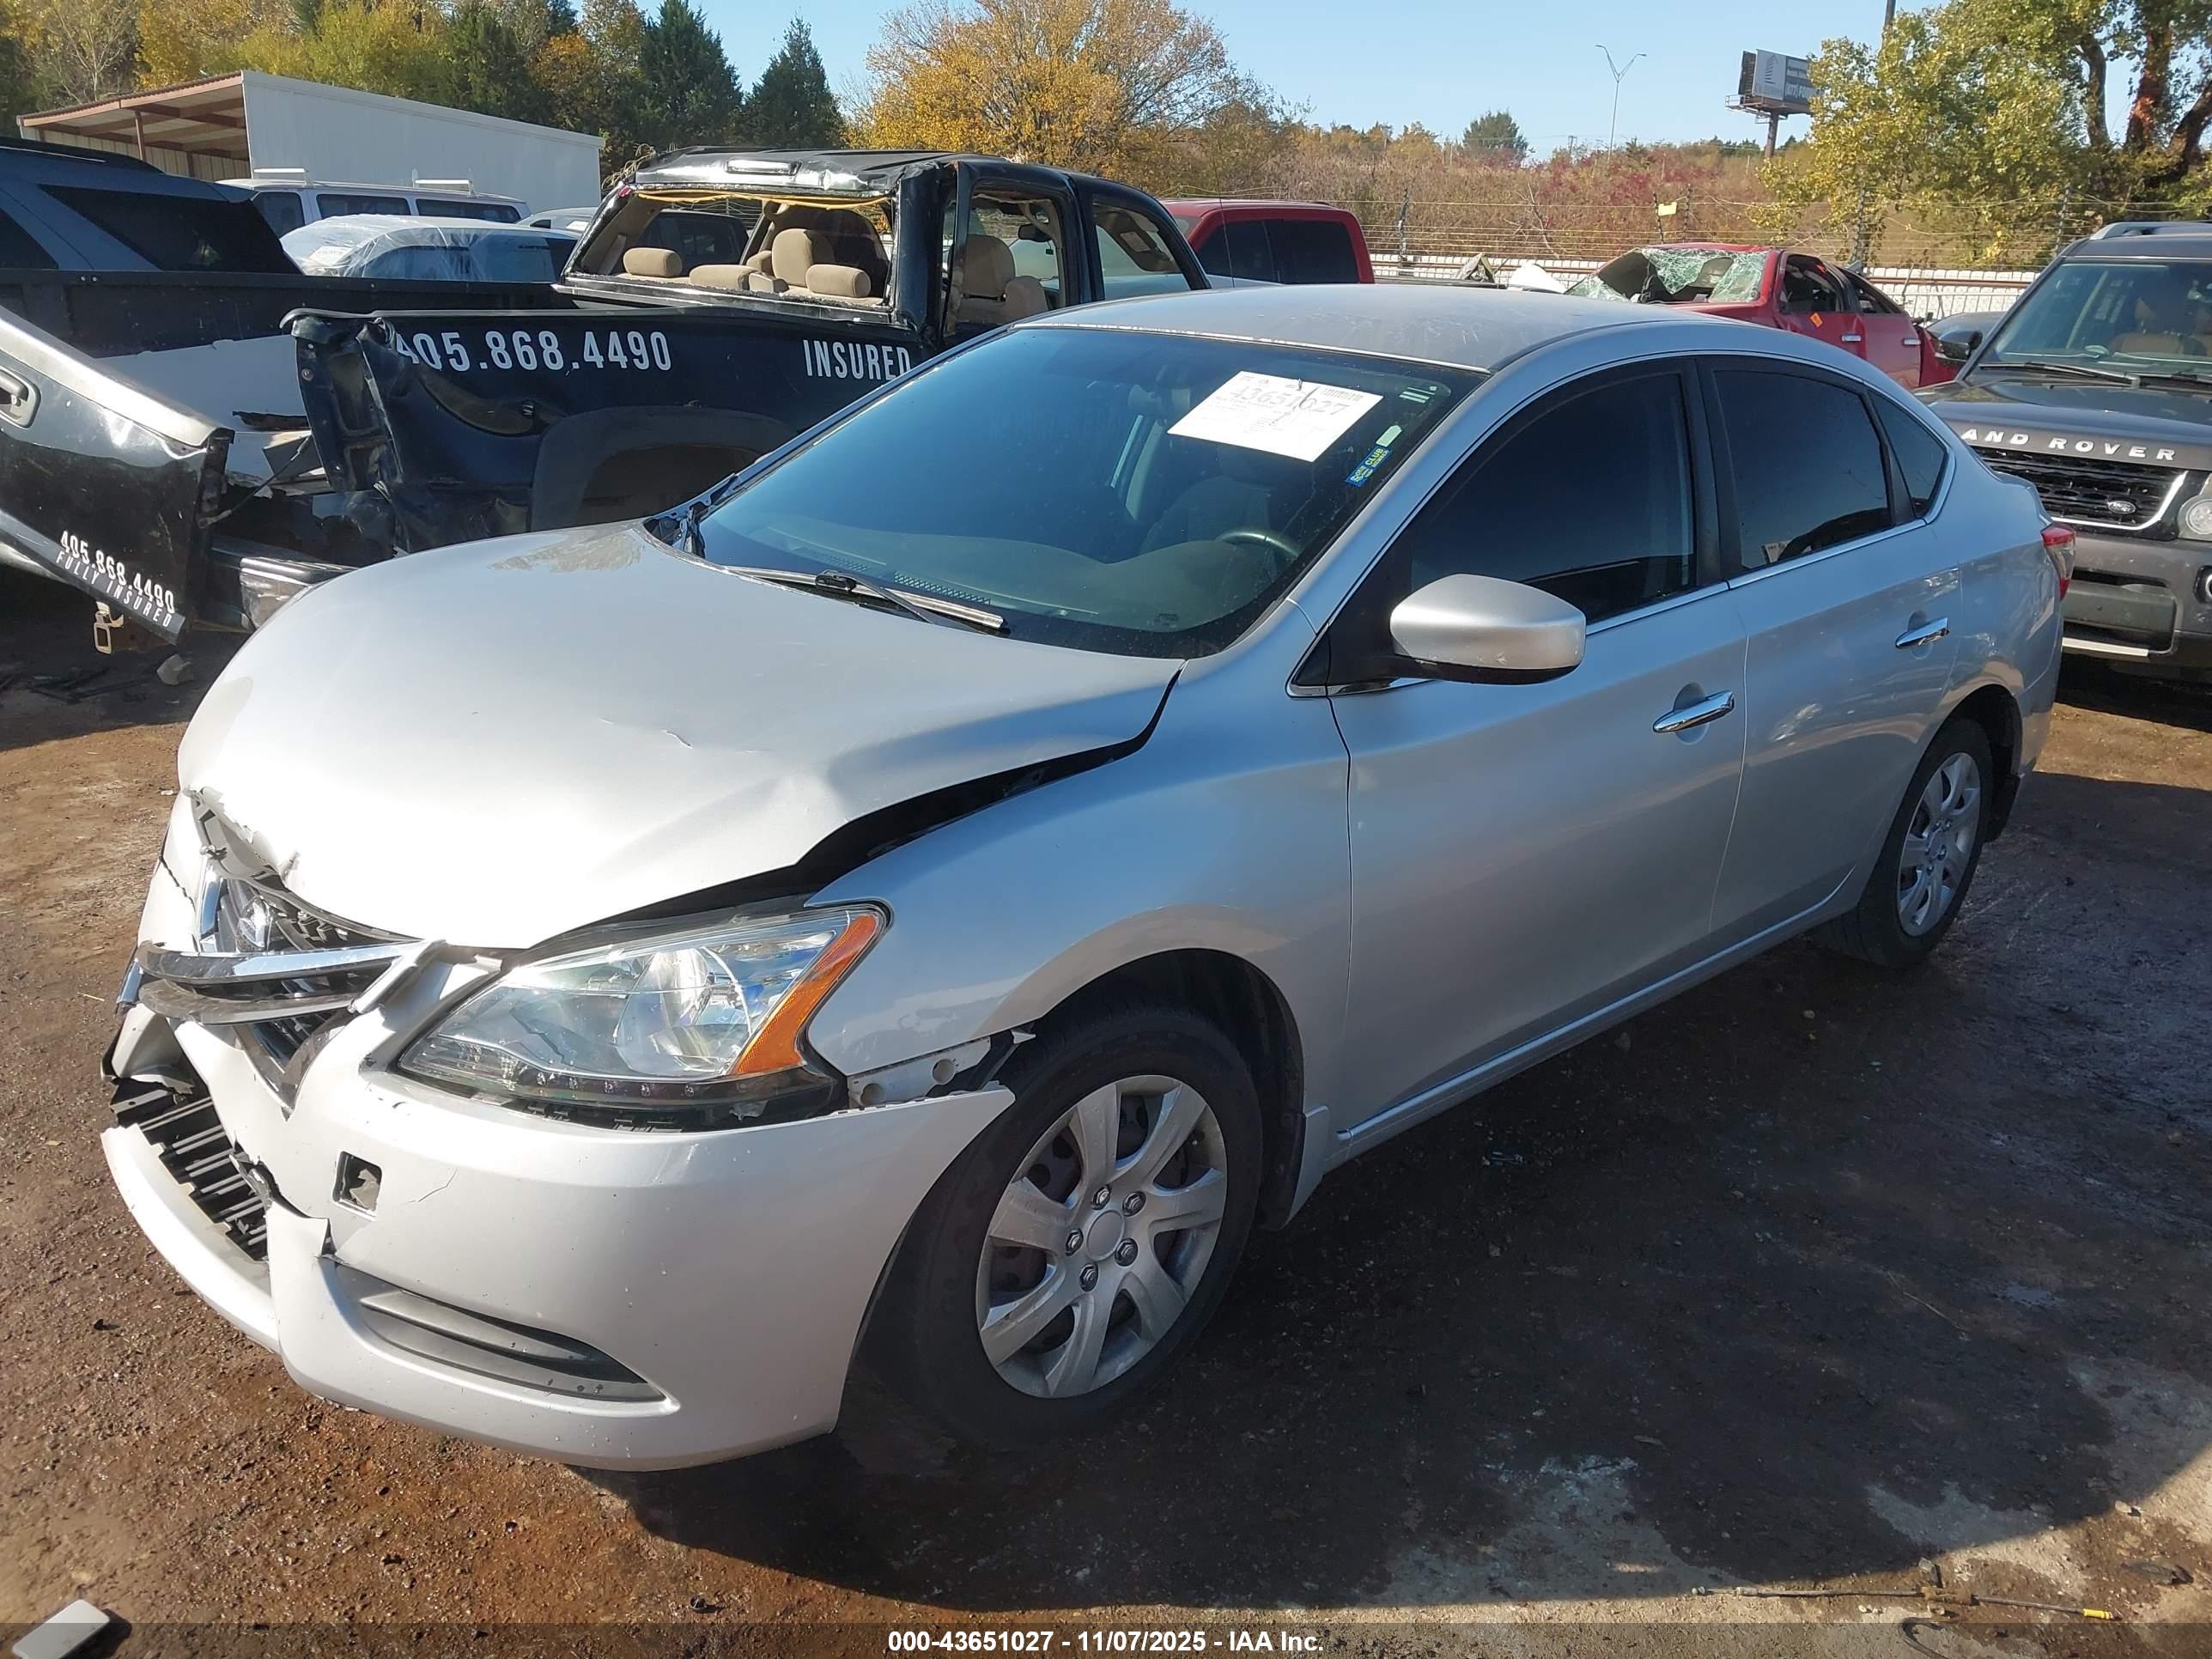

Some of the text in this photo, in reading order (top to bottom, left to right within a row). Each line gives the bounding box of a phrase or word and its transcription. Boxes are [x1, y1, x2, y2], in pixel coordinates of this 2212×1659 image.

[396, 331, 911, 380] 405.868.4490 INSURED
[1365, 448, 1383, 465] CLUB
[1961, 428, 2176, 461] AND ROVER
[56, 551, 173, 627] FULLY INSURED
[60, 530, 175, 614] 405.868.4490
